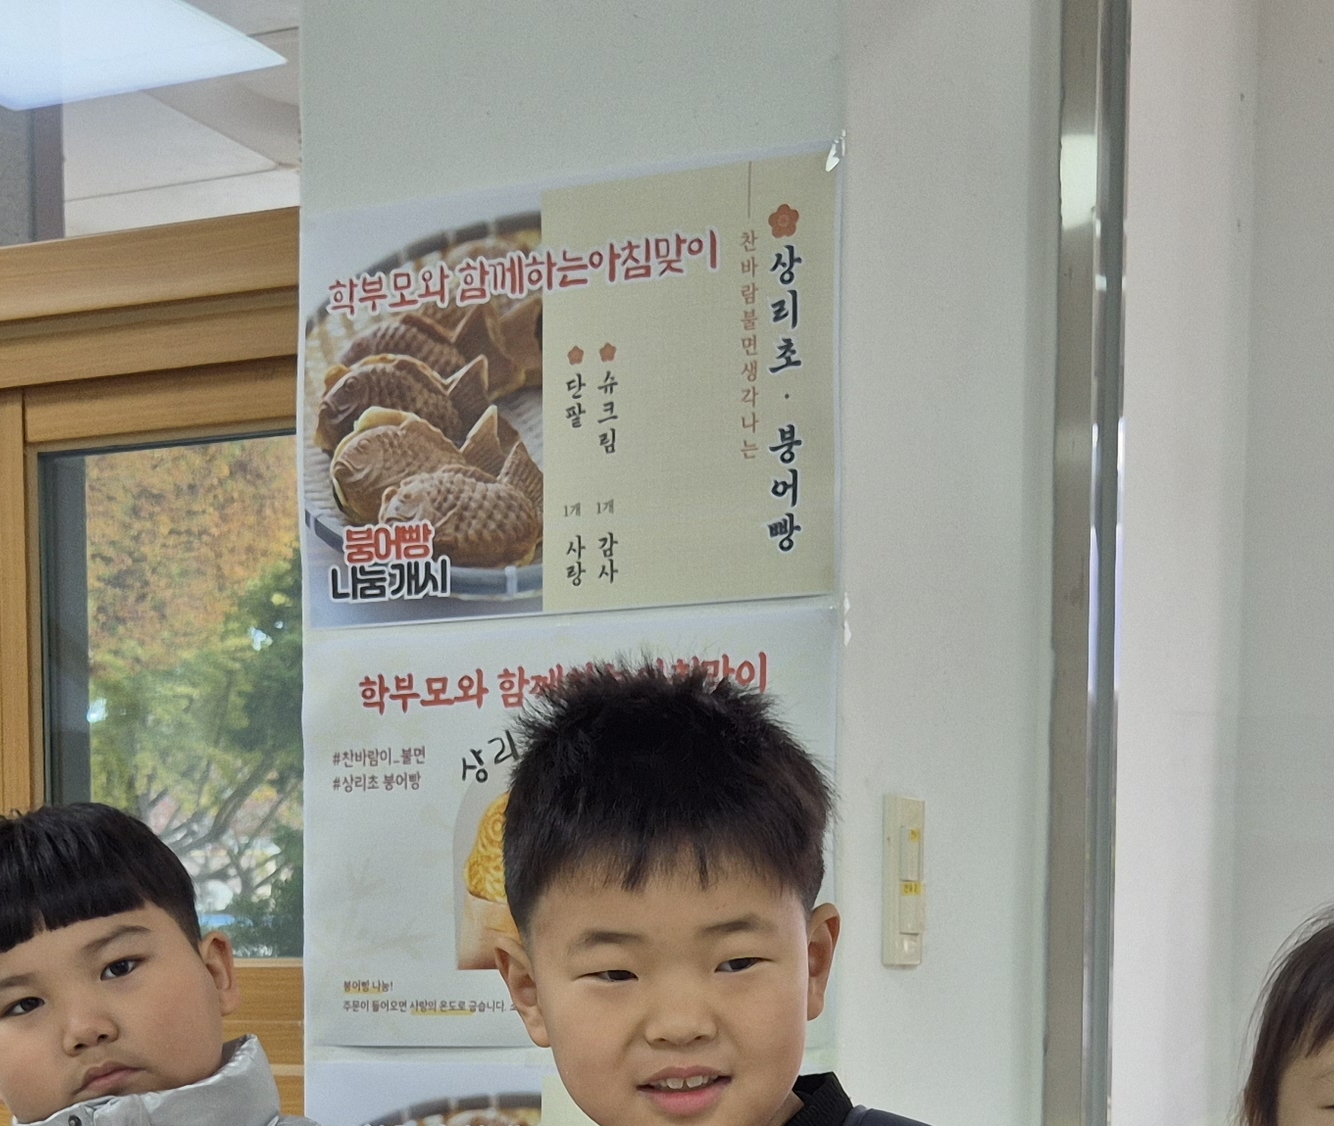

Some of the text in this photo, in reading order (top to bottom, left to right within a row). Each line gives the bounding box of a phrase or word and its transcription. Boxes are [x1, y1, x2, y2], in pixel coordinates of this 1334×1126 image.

[328, 264, 450, 316] 학부모와
[767, 244, 802, 552] 상리초 붕어빵
[563, 372, 587, 587] 단팥 1개 사랑
[596, 370, 619, 584] 슈크림 1개 감사
[345, 522, 433, 564] 붕어빵
[358, 668, 489, 716] 학부모와
[332, 771, 422, 793] #상리초 붕어빵
[343, 1000, 369, 1012] 주문이
